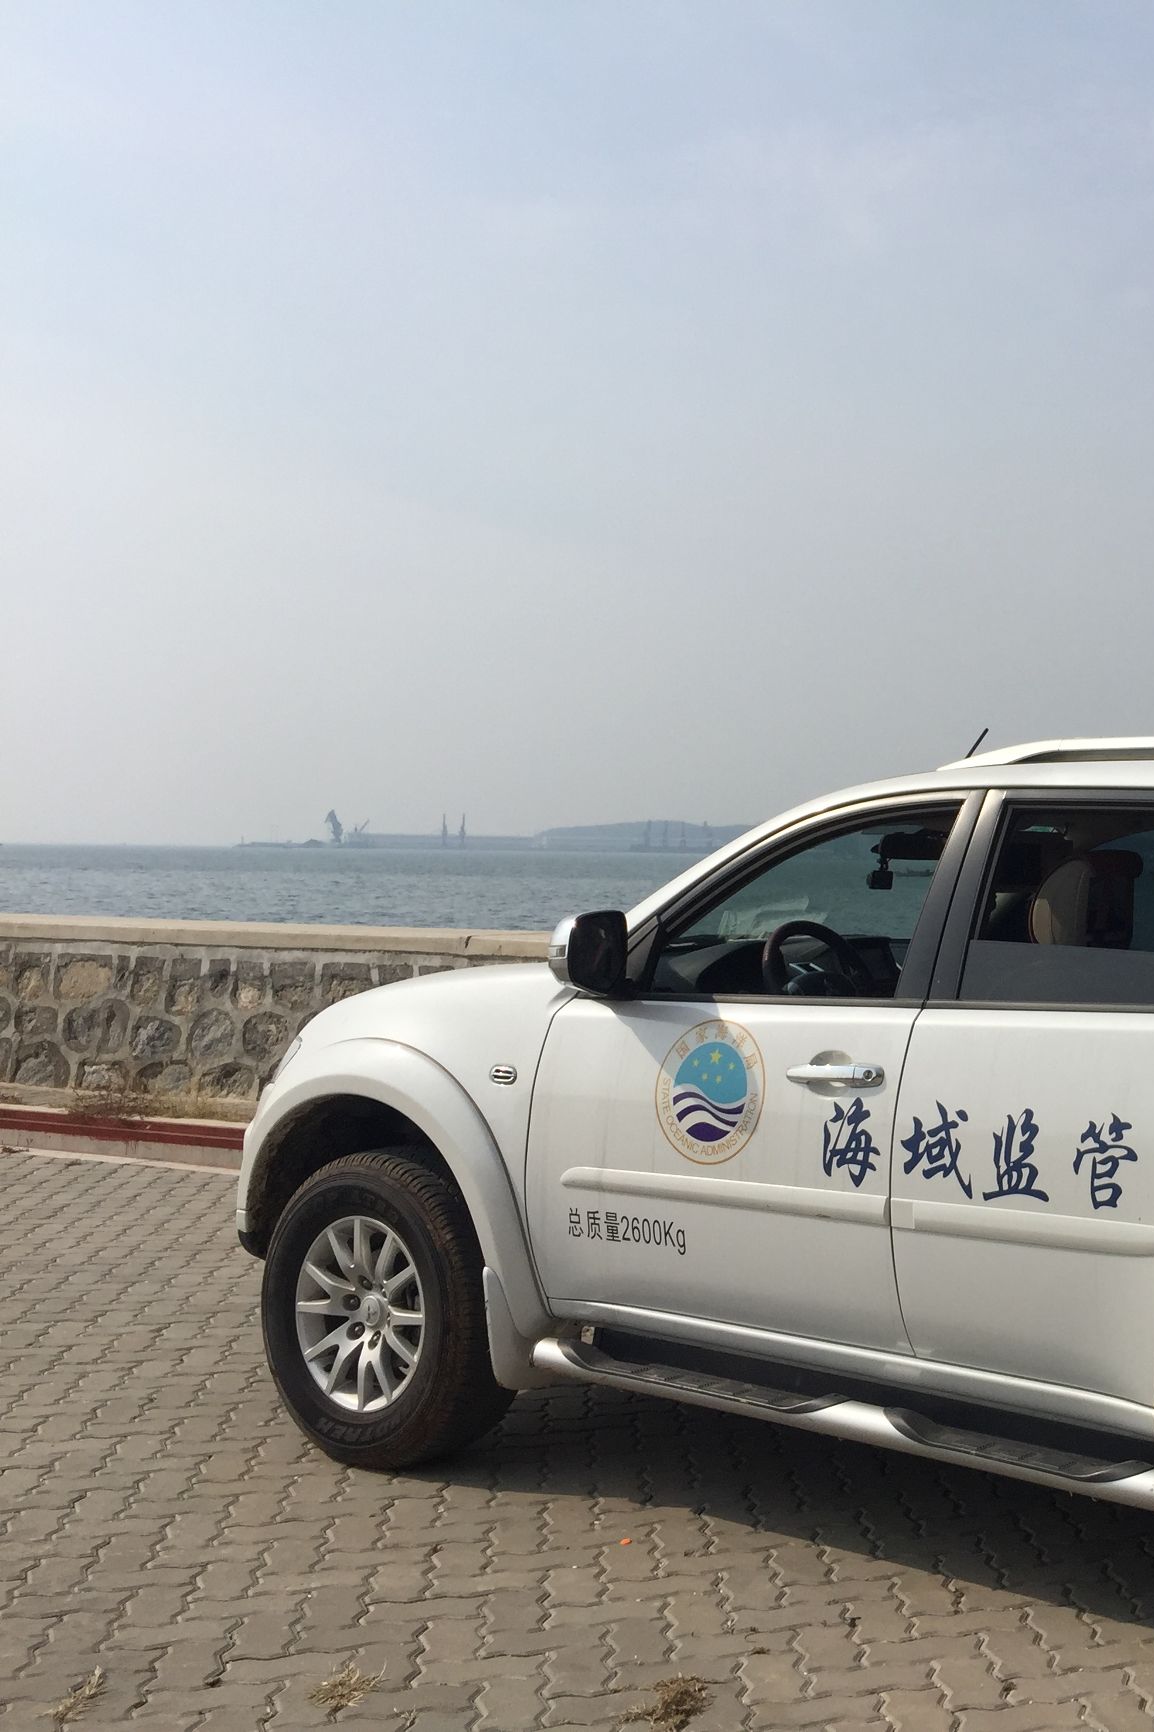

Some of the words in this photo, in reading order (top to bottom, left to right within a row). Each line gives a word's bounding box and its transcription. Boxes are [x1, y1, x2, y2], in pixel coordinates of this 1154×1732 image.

[662, 1078, 672, 1115] STATE
[665, 1115, 699, 1154] OCEANIC
[702, 1092, 758, 1157] ADMINISTRATION
[822, 1096, 1138, 1210] 海域监管
[568, 1207, 687, 1256] 总质量2600Kg
